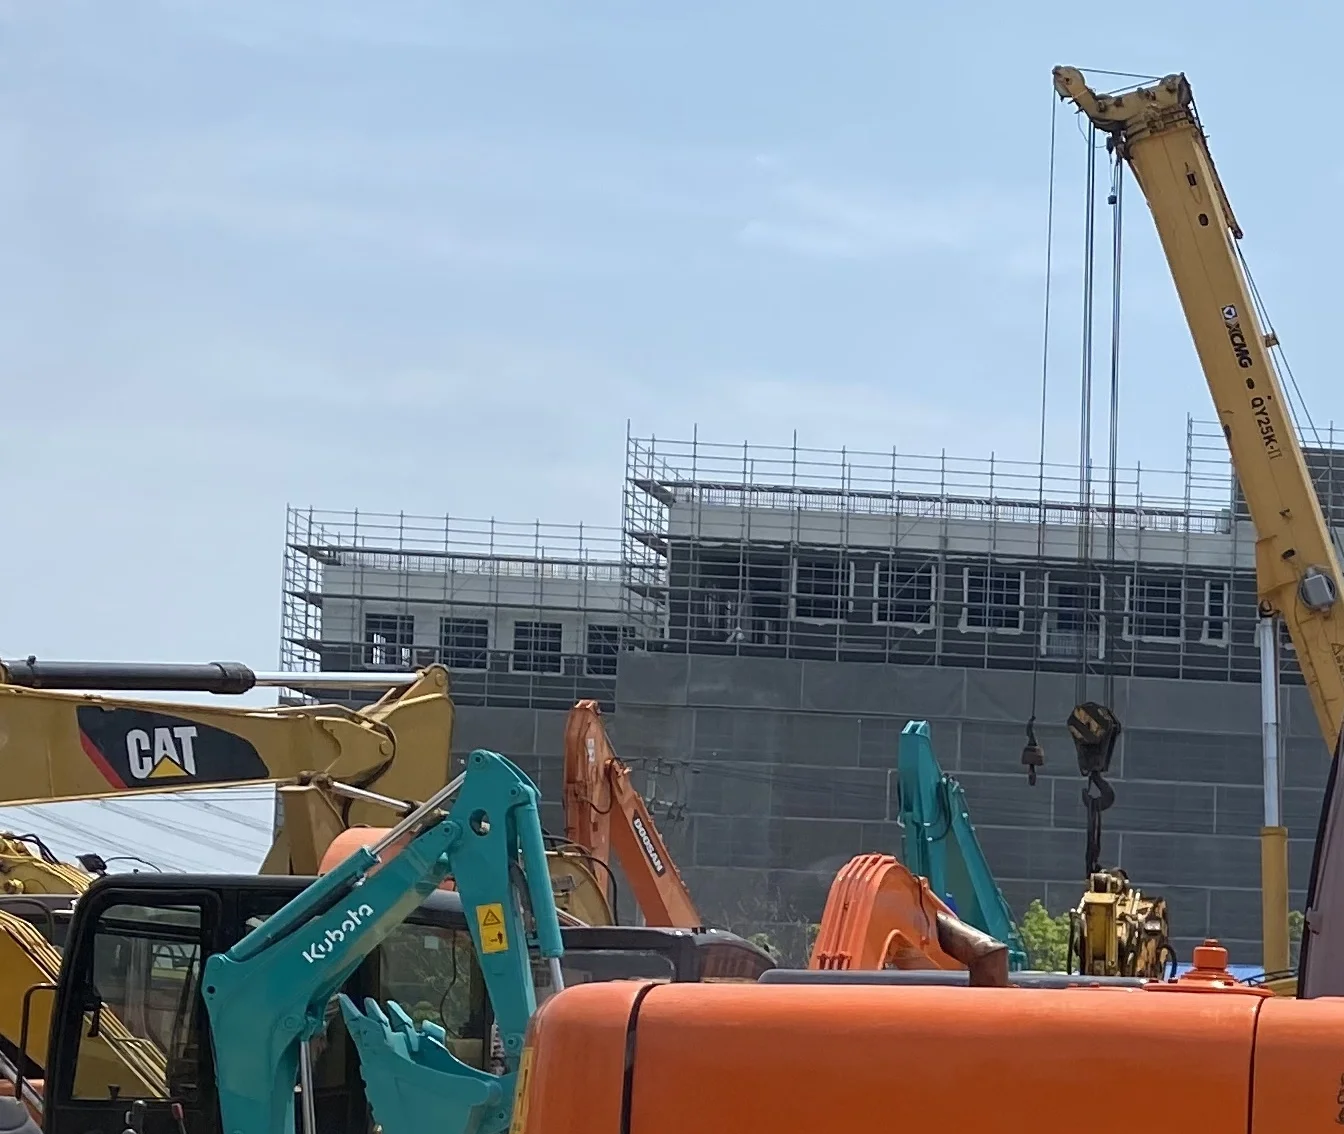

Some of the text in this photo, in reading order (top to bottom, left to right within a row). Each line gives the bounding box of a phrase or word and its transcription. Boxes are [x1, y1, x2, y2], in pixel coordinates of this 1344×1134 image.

[1226, 321, 1253, 369] XCMG
[126, 726, 198, 779] CAT
[634, 818, 663, 872] DOOSAN
[302, 904, 374, 963] Kubota
